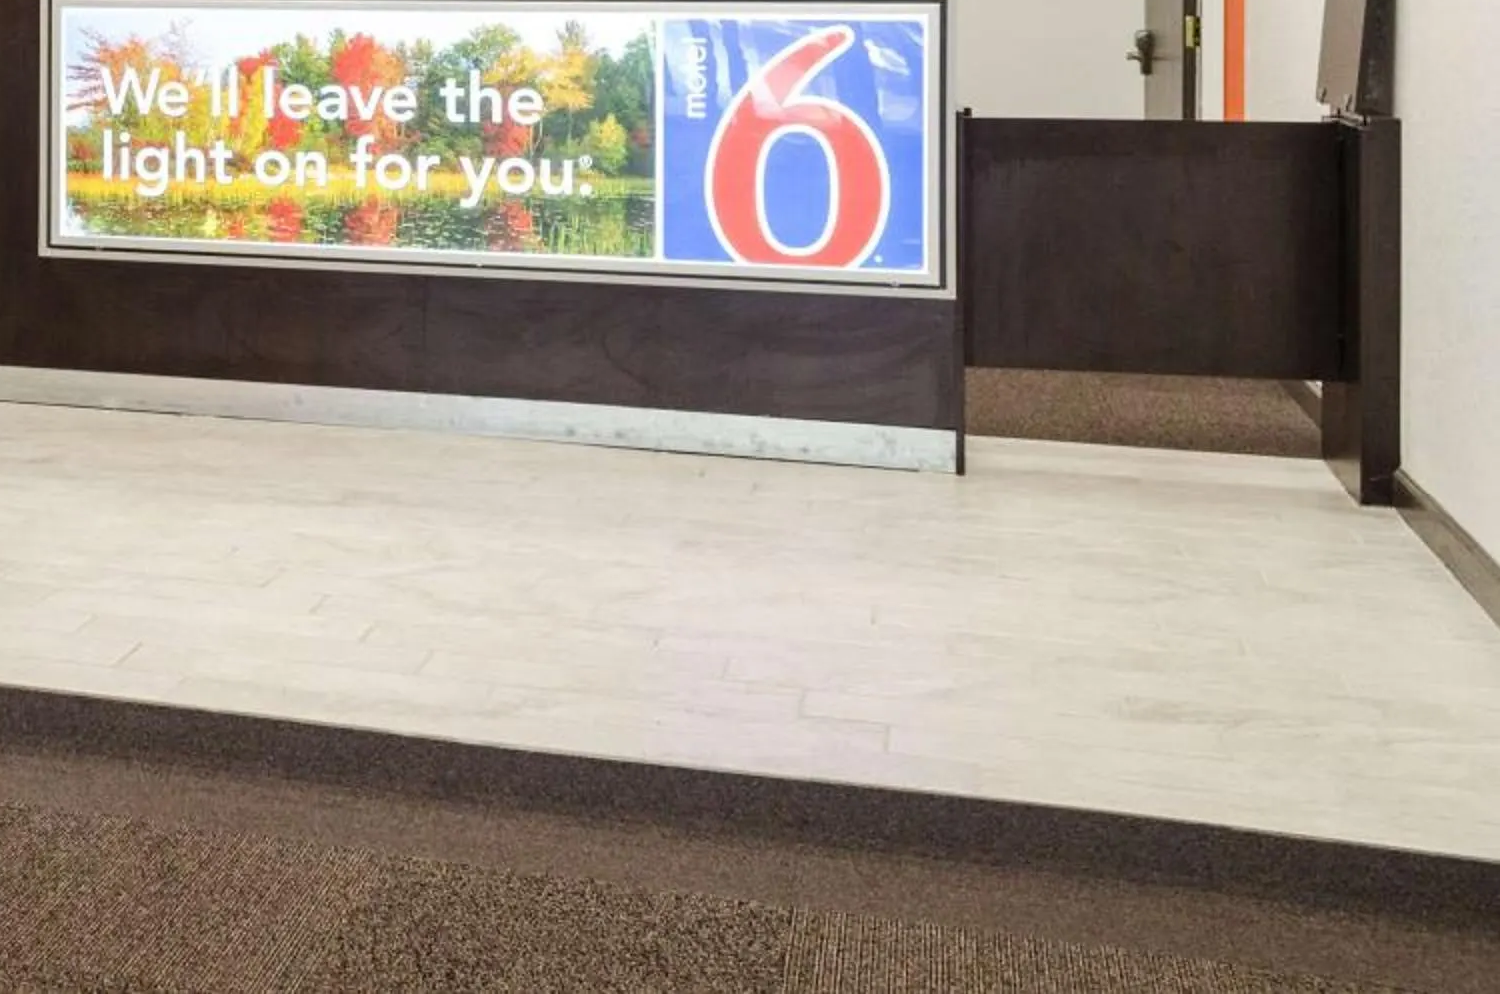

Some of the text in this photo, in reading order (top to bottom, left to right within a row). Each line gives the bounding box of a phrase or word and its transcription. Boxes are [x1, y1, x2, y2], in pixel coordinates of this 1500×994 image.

[100, 64, 545, 125] We'll leave the
[102, 129, 233, 197] light
[255, 150, 328, 187] on
[350, 134, 440, 191] for
[704, 24, 891, 268] 6
